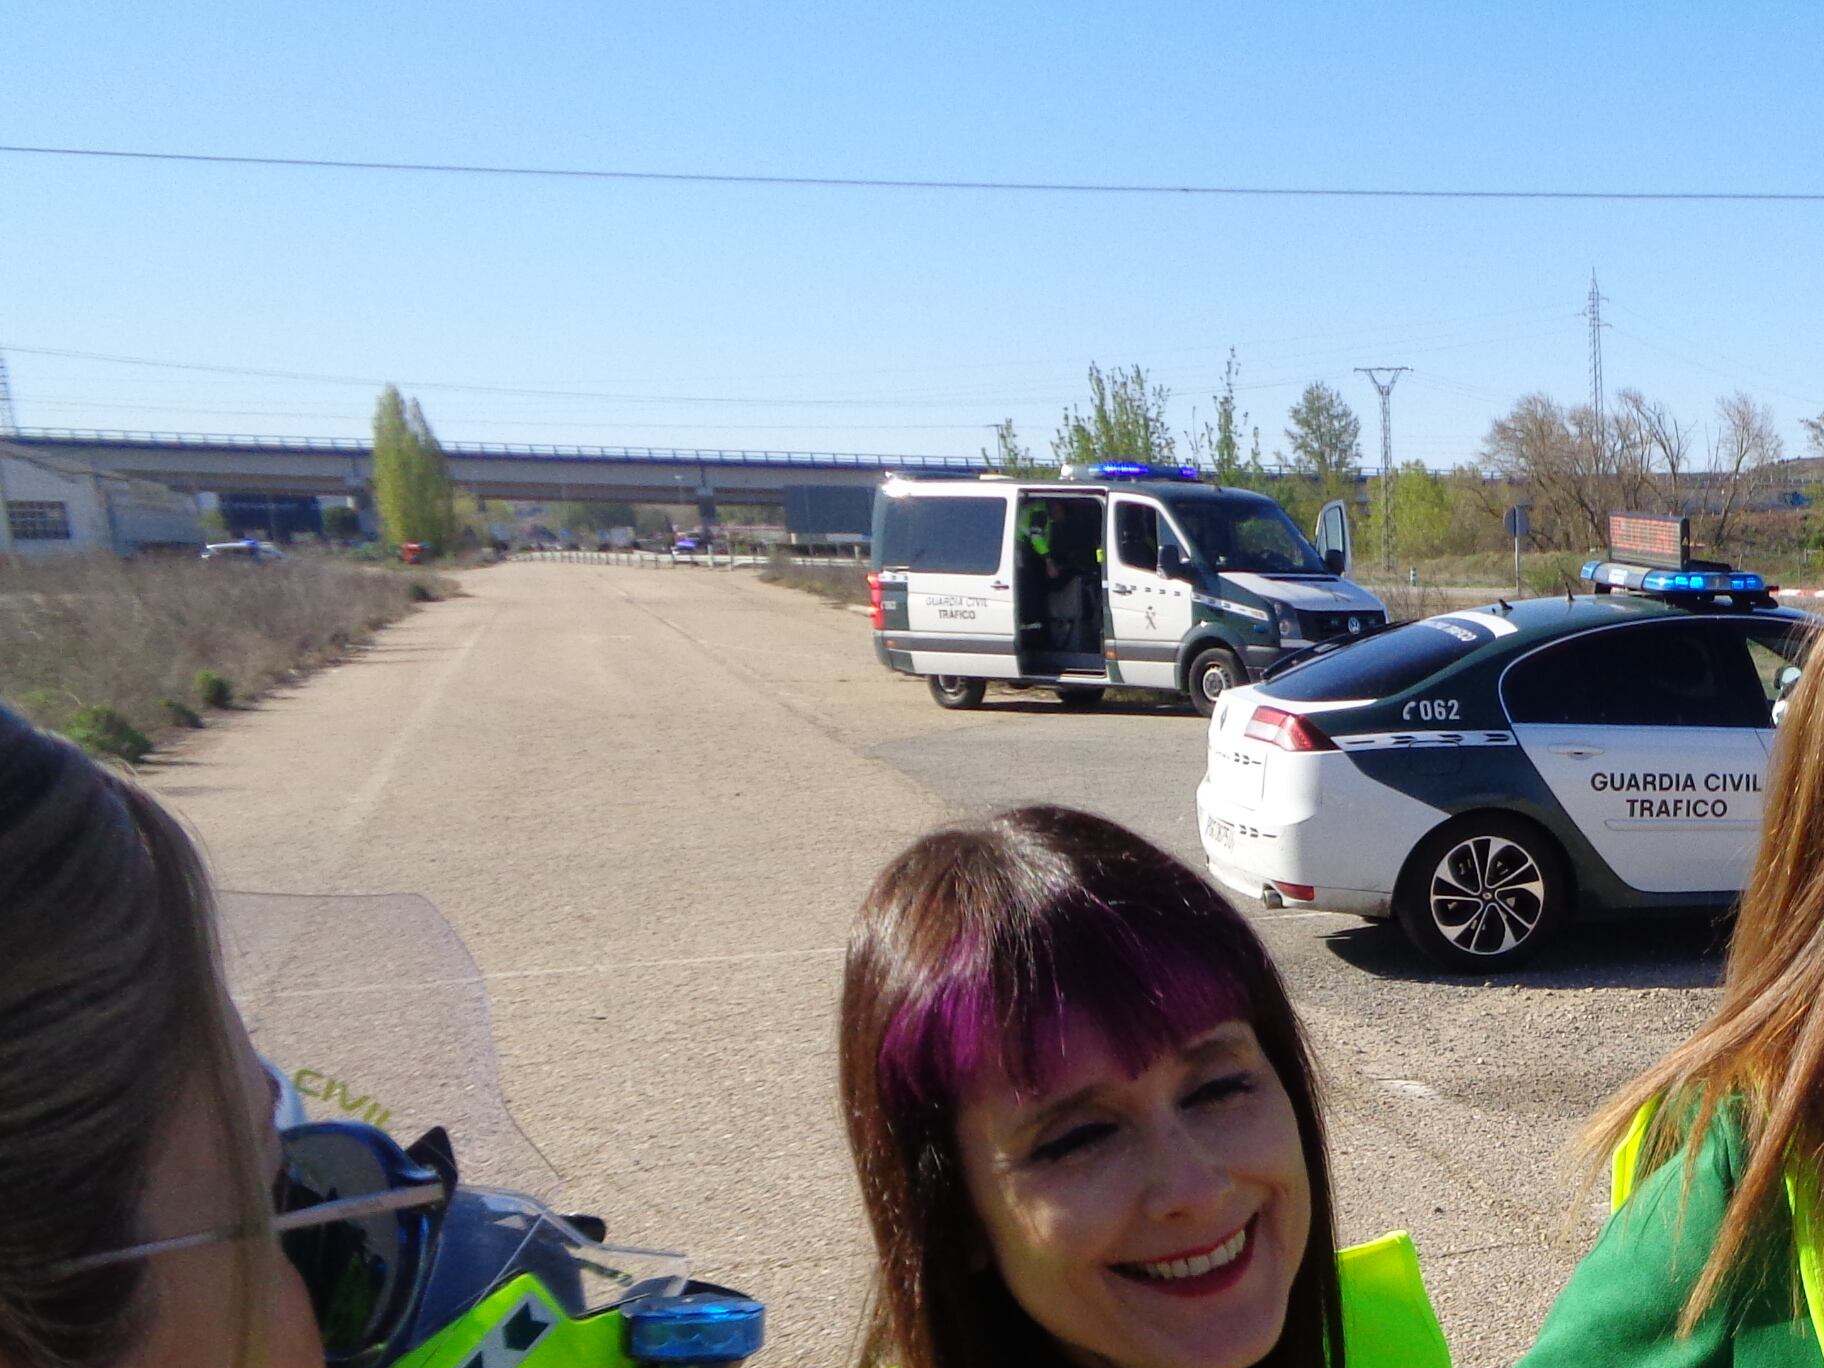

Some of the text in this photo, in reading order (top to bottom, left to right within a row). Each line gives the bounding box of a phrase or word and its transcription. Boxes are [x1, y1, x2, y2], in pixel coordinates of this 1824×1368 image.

[926, 597, 988, 607] GUARDIA CIVIL
[1419, 699, 1461, 721] 062
[1590, 772, 1763, 792] GUARDIA CIVIL
[1626, 799, 1728, 818] TRAFICO
